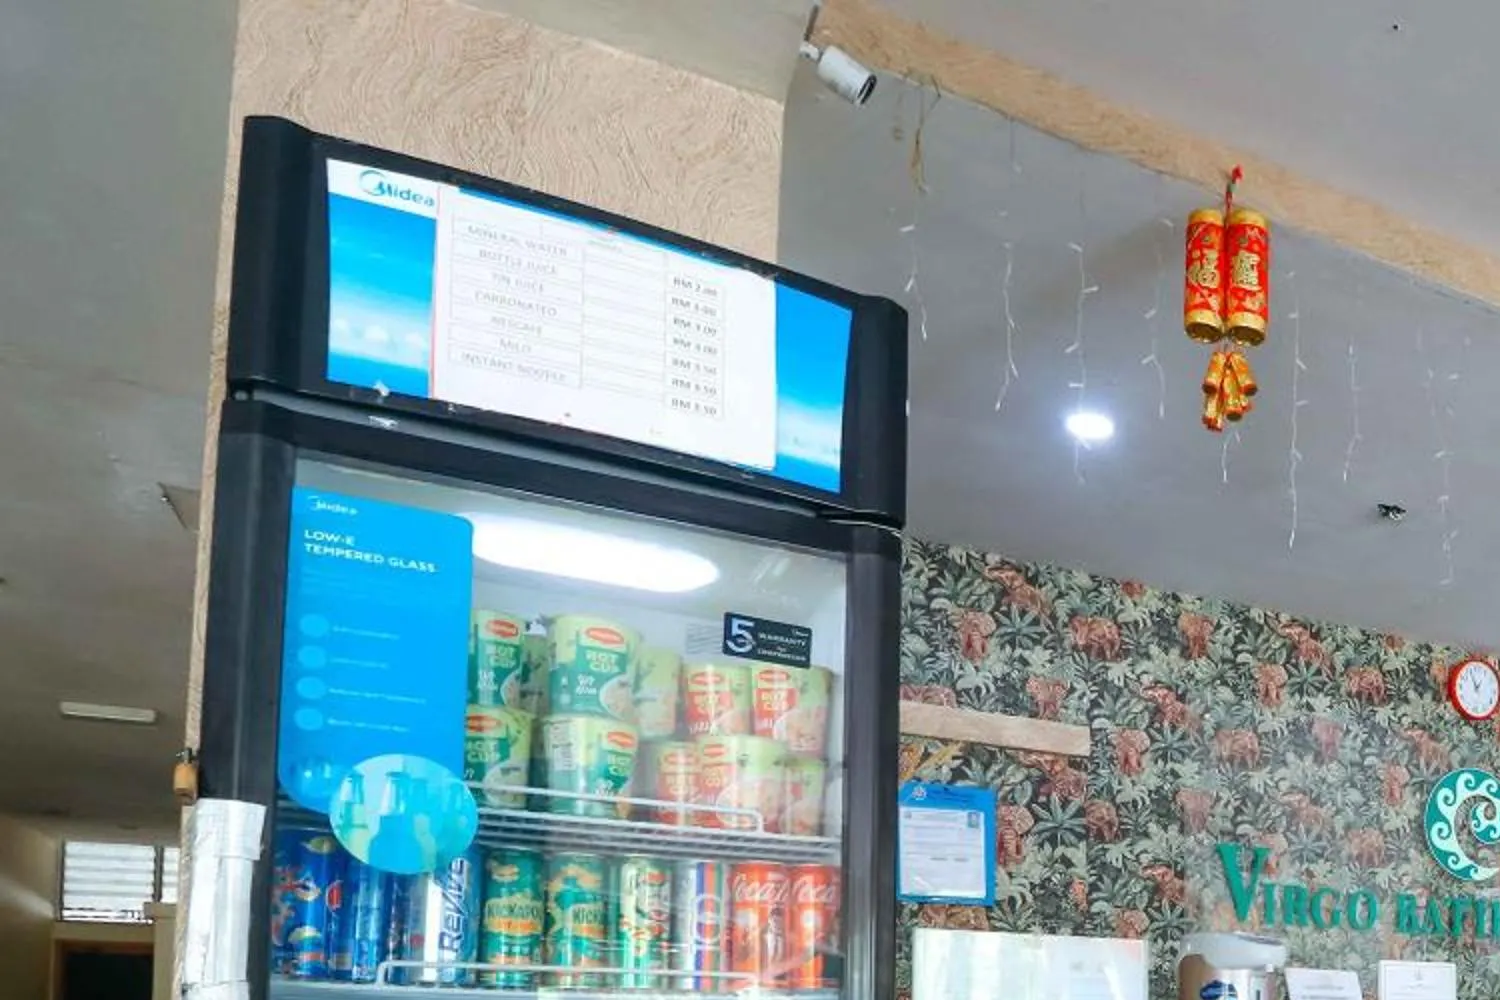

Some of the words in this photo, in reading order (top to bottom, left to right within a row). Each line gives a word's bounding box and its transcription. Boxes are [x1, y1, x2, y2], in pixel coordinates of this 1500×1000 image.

[360, 169, 436, 207] Midea
[303, 528, 355, 546] LOW-E
[303, 541, 385, 565] TEMPERED
[387, 555, 438, 573] GLASS
[725, 617, 755, 653] 5
[1215, 842, 1379, 932] VIRGO
